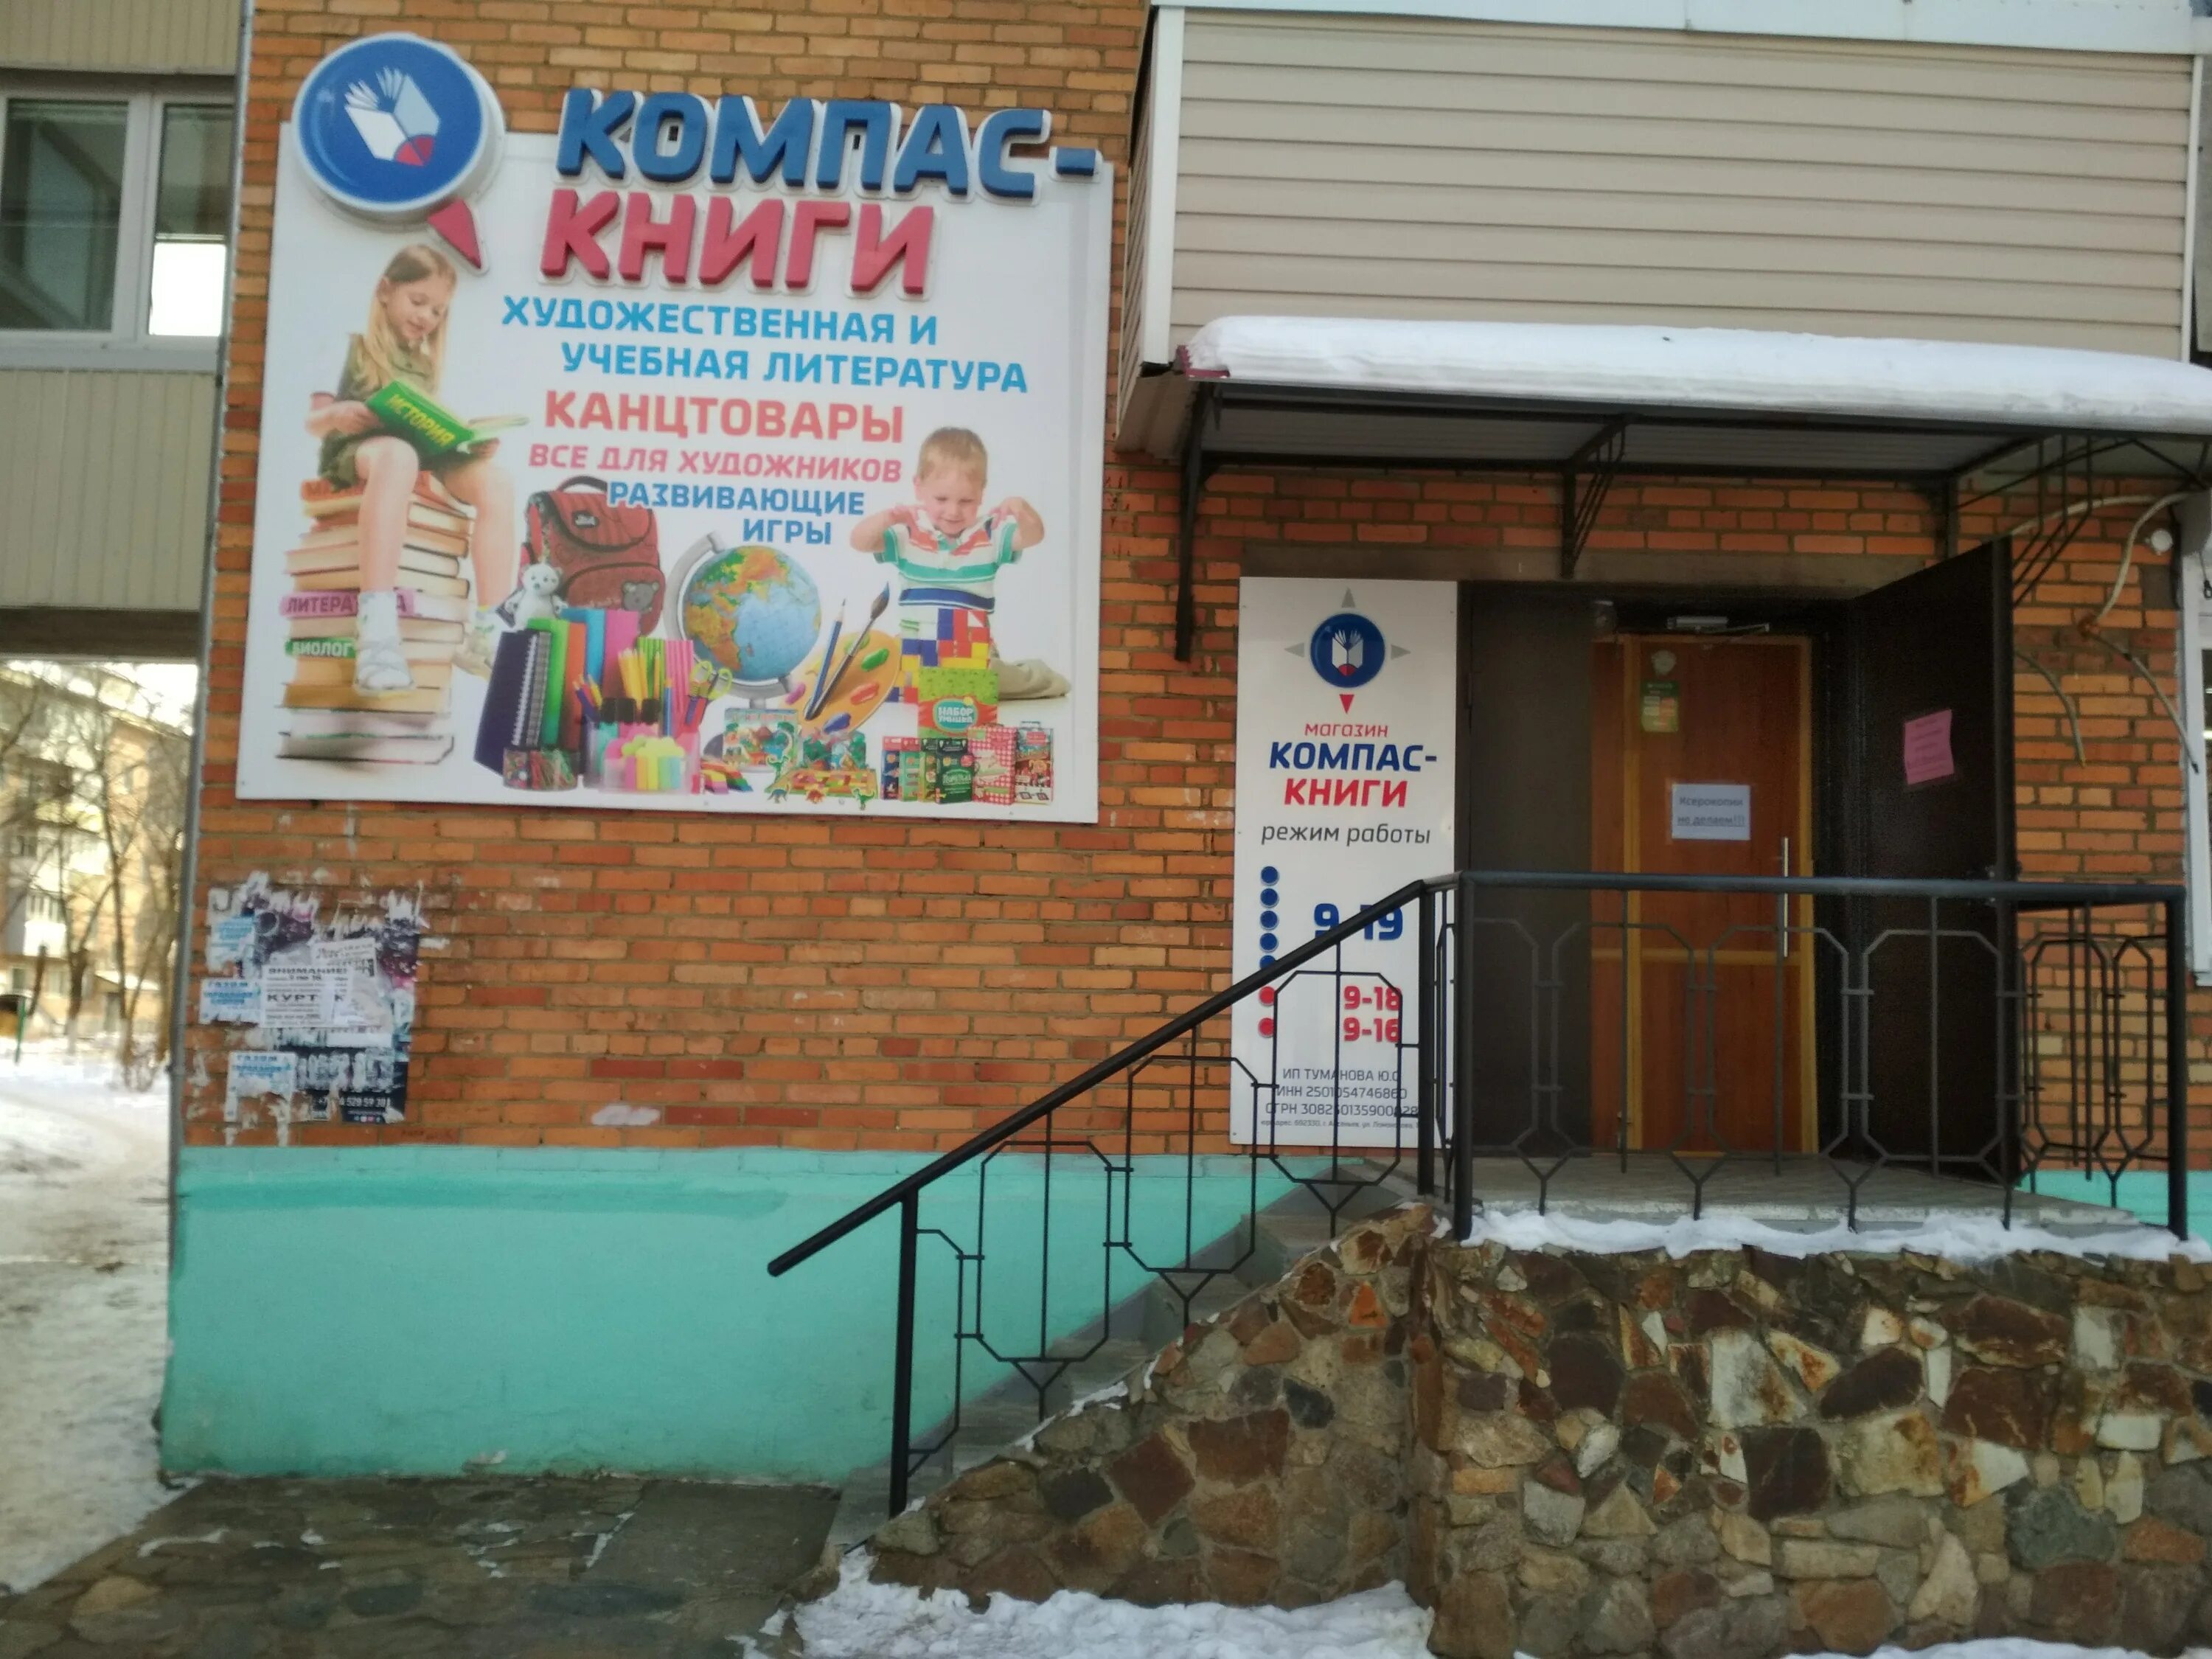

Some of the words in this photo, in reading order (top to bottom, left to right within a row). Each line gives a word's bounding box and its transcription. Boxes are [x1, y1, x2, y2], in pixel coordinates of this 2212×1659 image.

[556, 88, 1099, 199] КОМПАС-
[540, 189, 935, 294] КНИГИ
[502, 296, 895, 344] ХУДОЖЕСТВЕННАЯ
[911, 316, 938, 346] И
[562, 342, 749, 381] УЧЕБНАЯ
[763, 352, 1029, 394] ЛИТЕРАТУРА
[386, 394, 455, 447] ИСТОРИЯ
[544, 391, 905, 443] КАНЦТОВАРЫ
[529, 444, 588, 471] ВСЕ
[597, 447, 667, 474] ДЛЯ
[678, 451, 902, 483] ХУДОЖНИКОВ
[608, 481, 866, 515] РАЗВИВАЮЩИЕ
[742, 519, 832, 545] ИГРЫ
[293, 640, 350, 657] БИОЛОГ
[938, 706, 973, 717] НАБОР
[1304, 723, 1388, 737] магазин
[1269, 742, 1437, 772] КОМПАС-
[1284, 778, 1408, 808] КНИГИ
[1261, 825, 1339, 845] режим
[1346, 824, 1430, 846] работы
[1314, 902, 1404, 941] 919
[1343, 986, 1402, 1011] 9-18
[1343, 1017, 1401, 1043] 9-16
[1283, 1068, 1300, 1079] ИП
[1304, 1068, 1374, 1082] ТУМАНОВА
[1276, 1086, 1302, 1096] ИНН
